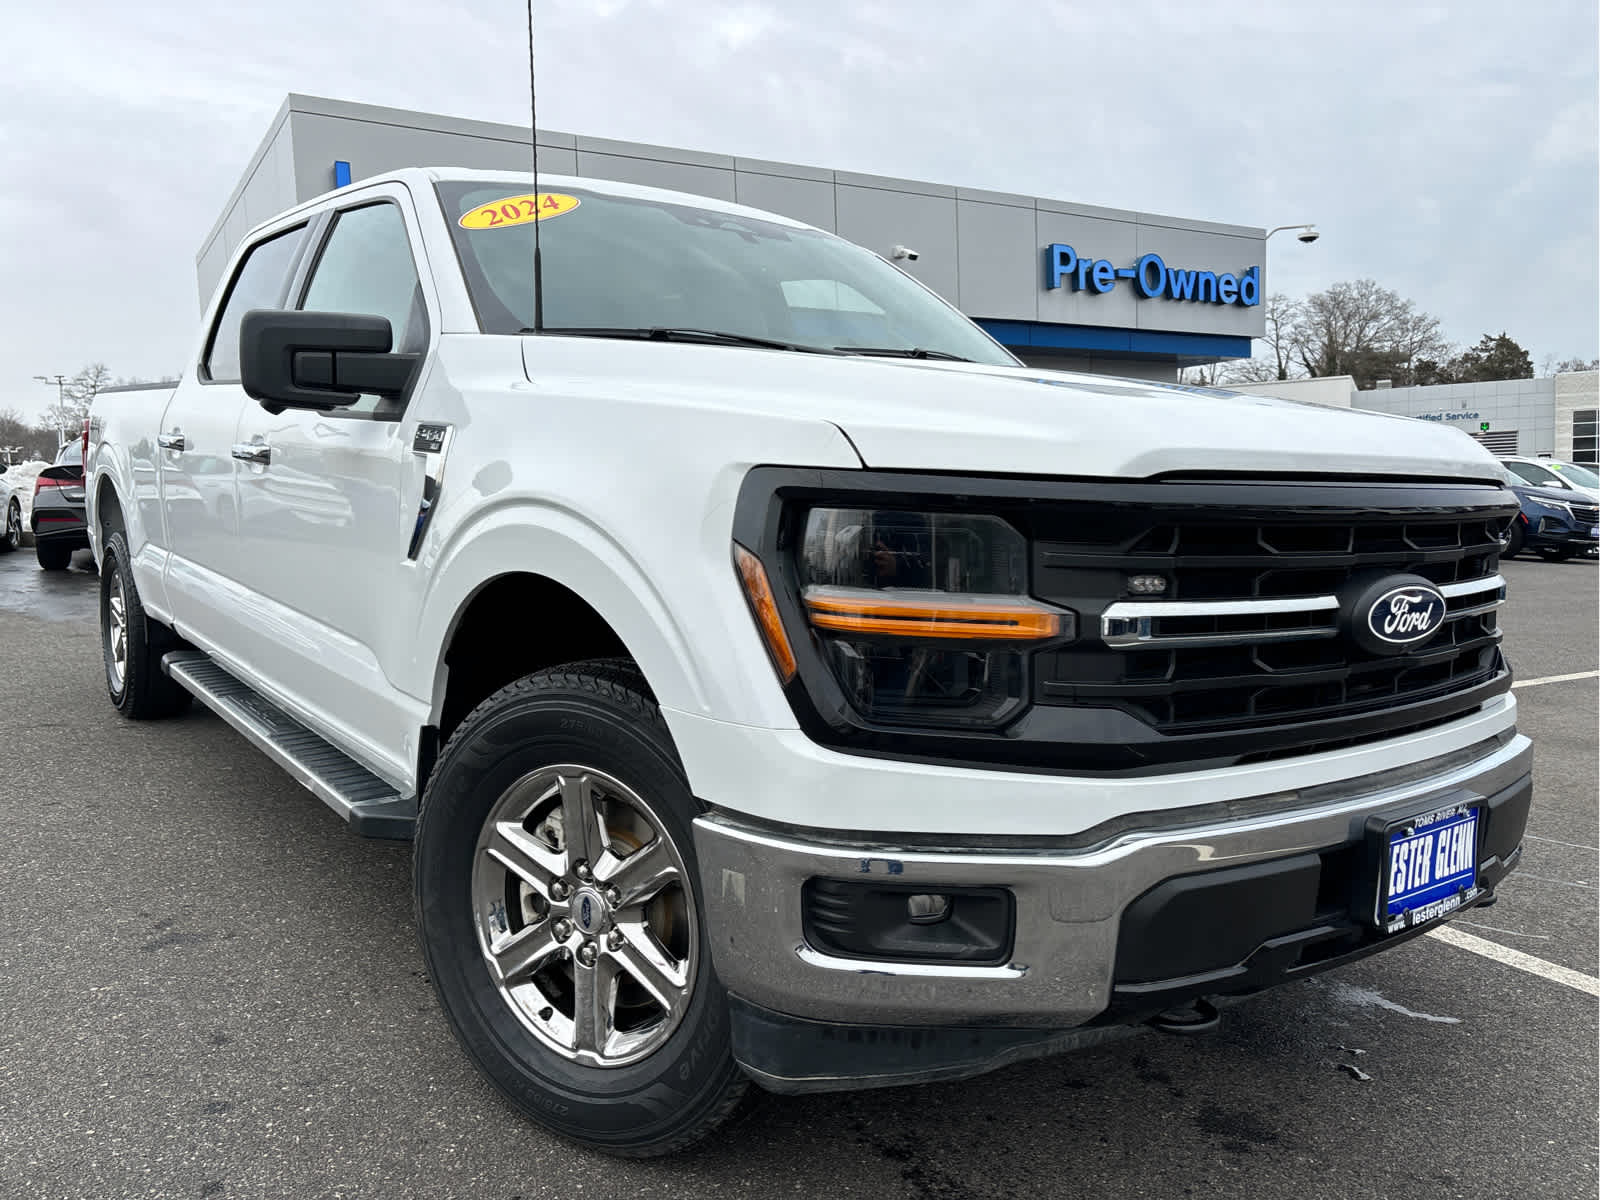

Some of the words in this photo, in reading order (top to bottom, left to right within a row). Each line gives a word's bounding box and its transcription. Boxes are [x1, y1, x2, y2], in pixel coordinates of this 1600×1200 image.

[480, 195, 560, 226] 2024
[1046, 243, 1260, 306] Pre-Owned
[1446, 412, 1479, 421] Service
[1384, 594, 1434, 635] Ford
[1414, 814, 1435, 829] TOMS
[1388, 834, 1434, 897] ESTER
[1434, 820, 1476, 880] GLENN
[1412, 896, 1461, 926] lesterglenn
